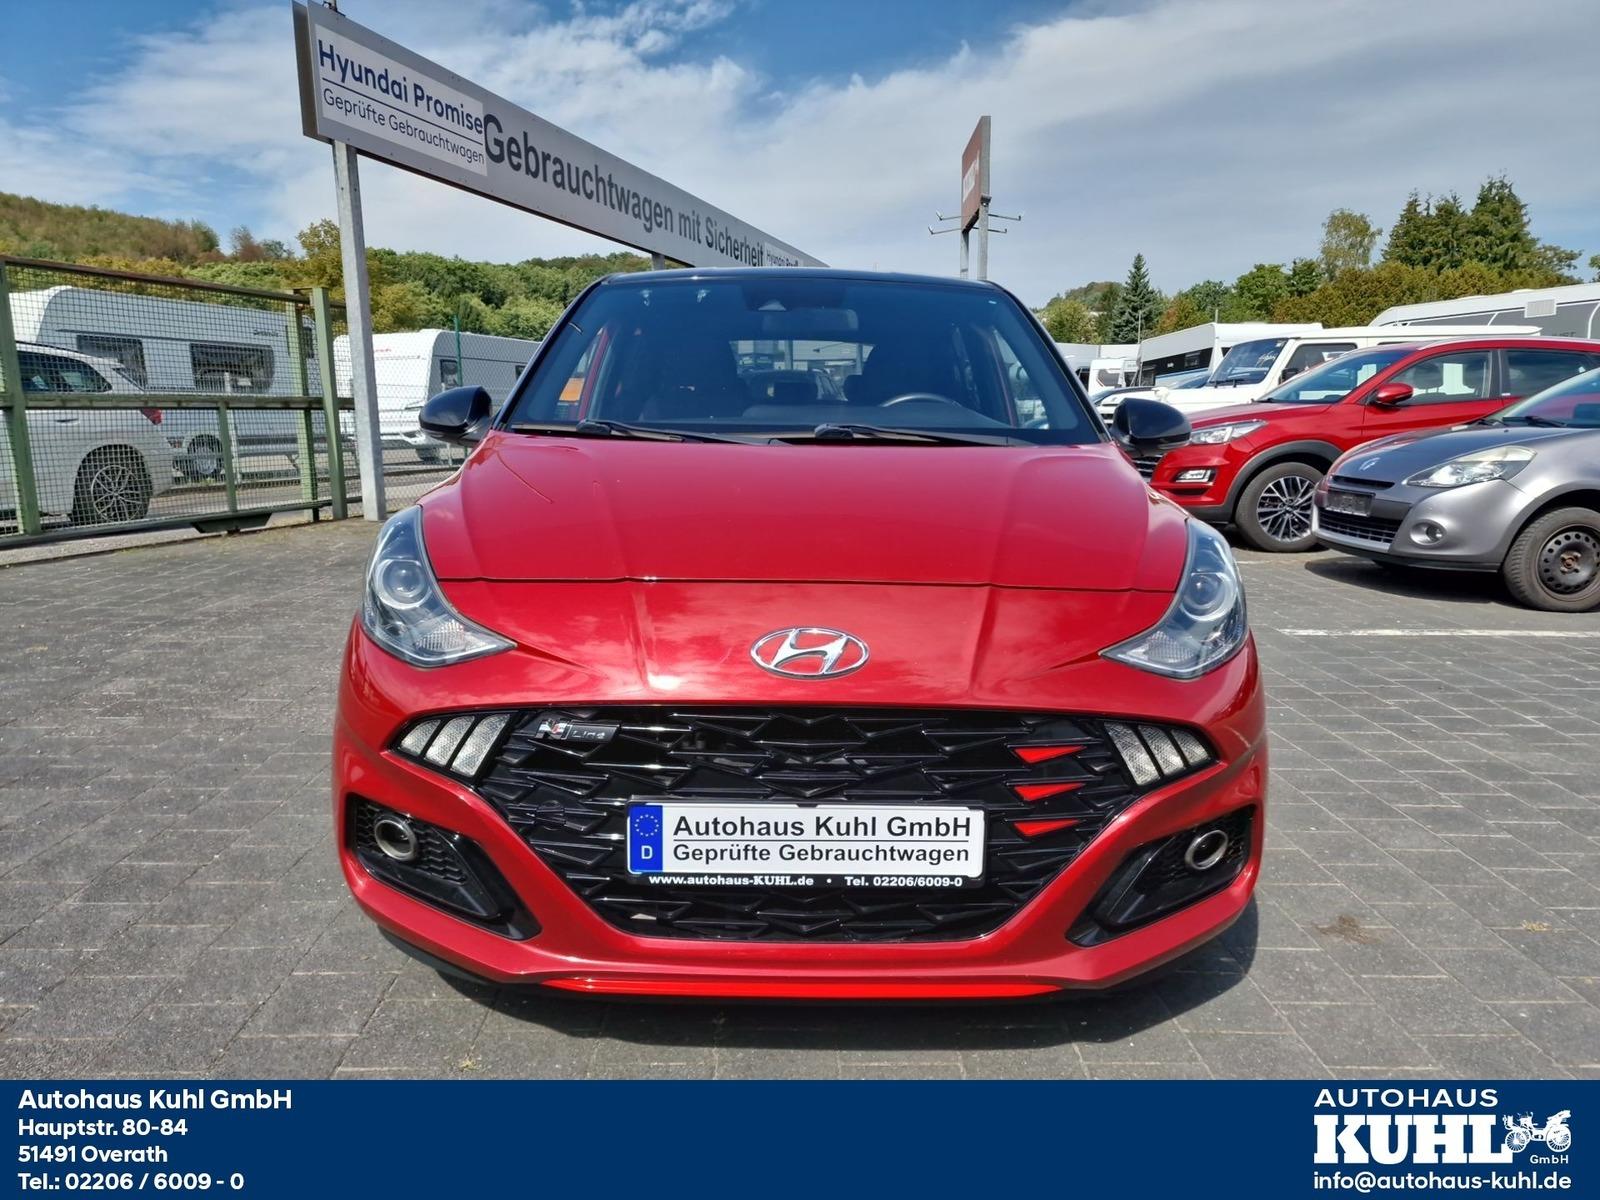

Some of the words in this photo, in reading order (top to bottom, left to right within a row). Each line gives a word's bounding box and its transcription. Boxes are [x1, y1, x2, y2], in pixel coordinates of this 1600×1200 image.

[318, 39, 408, 104] Hyundai
[414, 83, 483, 135] Promise
[323, 88, 385, 126] Geprüfte
[388, 110, 485, 166] Gebrauchtwagen
[483, 113, 674, 233] Gebrauchtwagen
[678, 209, 702, 244] mit
[705, 216, 764, 267] Sicherheit
[673, 815, 805, 838] Autohaus
[815, 815, 877, 838] Kuhl
[886, 816, 971, 838] GmbH
[640, 845, 653, 860] D
[673, 843, 771, 864] Geprüfte
[778, 843, 969, 866] Gebrauchtwagen
[648, 875, 814, 887] www.autohaus-KUHL.de
[845, 876, 869, 887] Tel.
[872, 876, 963, 888] 02206/6009-0
